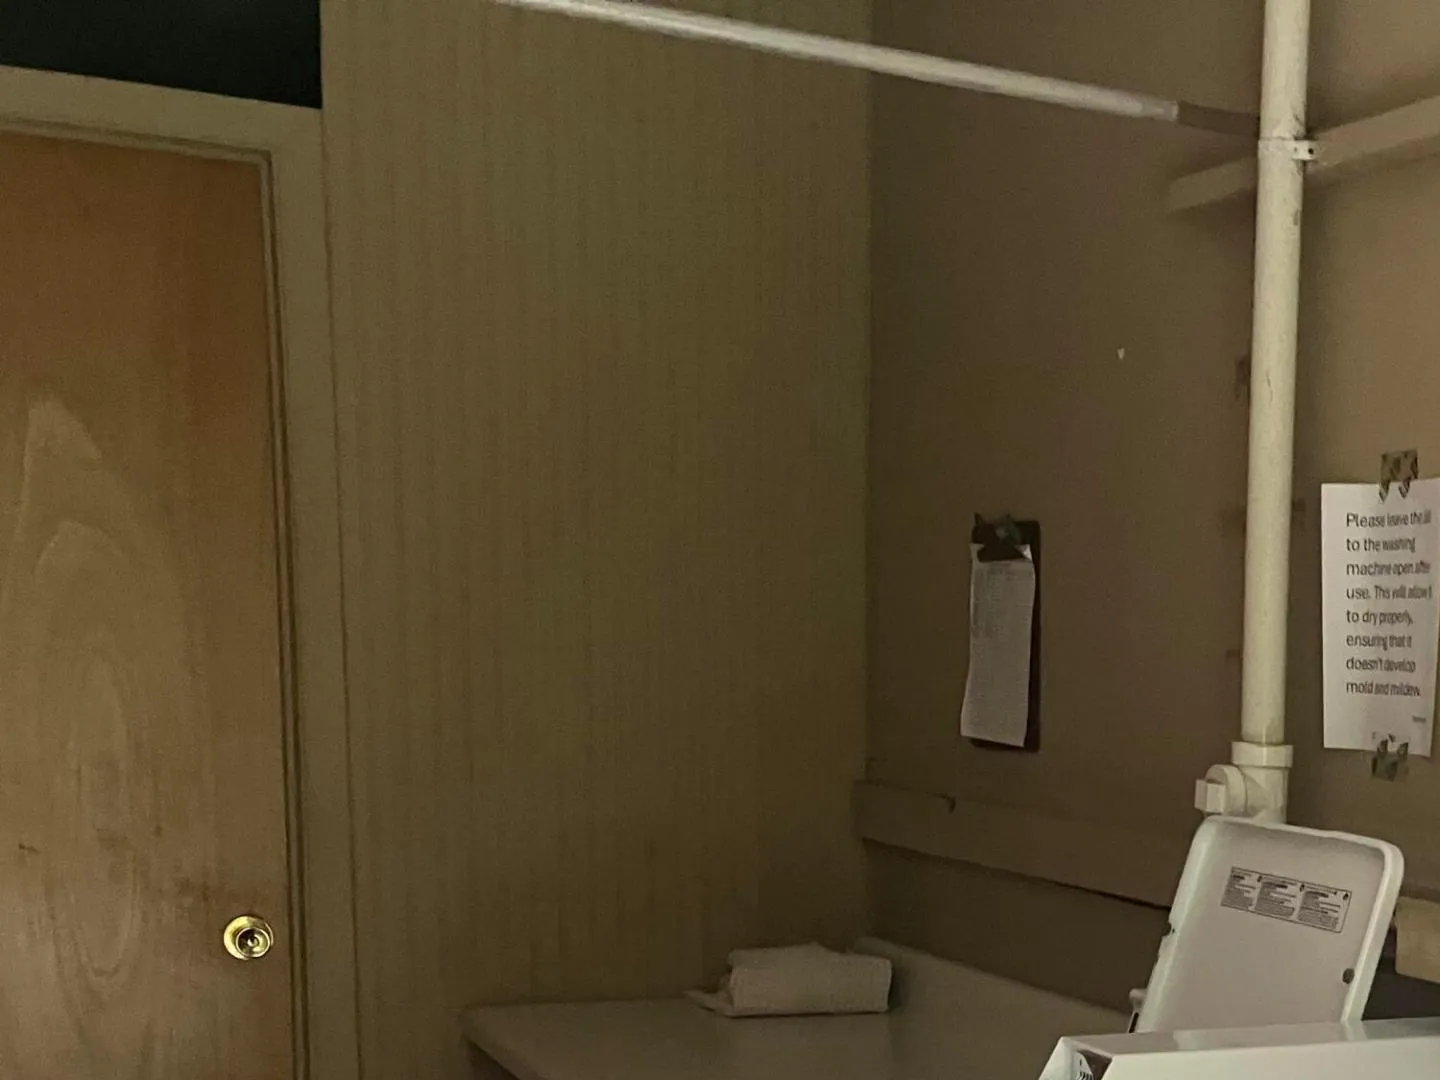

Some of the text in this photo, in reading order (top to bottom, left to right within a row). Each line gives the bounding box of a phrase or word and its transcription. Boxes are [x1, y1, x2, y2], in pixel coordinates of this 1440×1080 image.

[1346, 512, 1385, 527] Please
[1346, 538, 1360, 551] to
[1364, 538, 1380, 552] the
[1346, 609, 1359, 623] to
[1362, 609, 1377, 626] dry
[1346, 681, 1374, 694] mold
